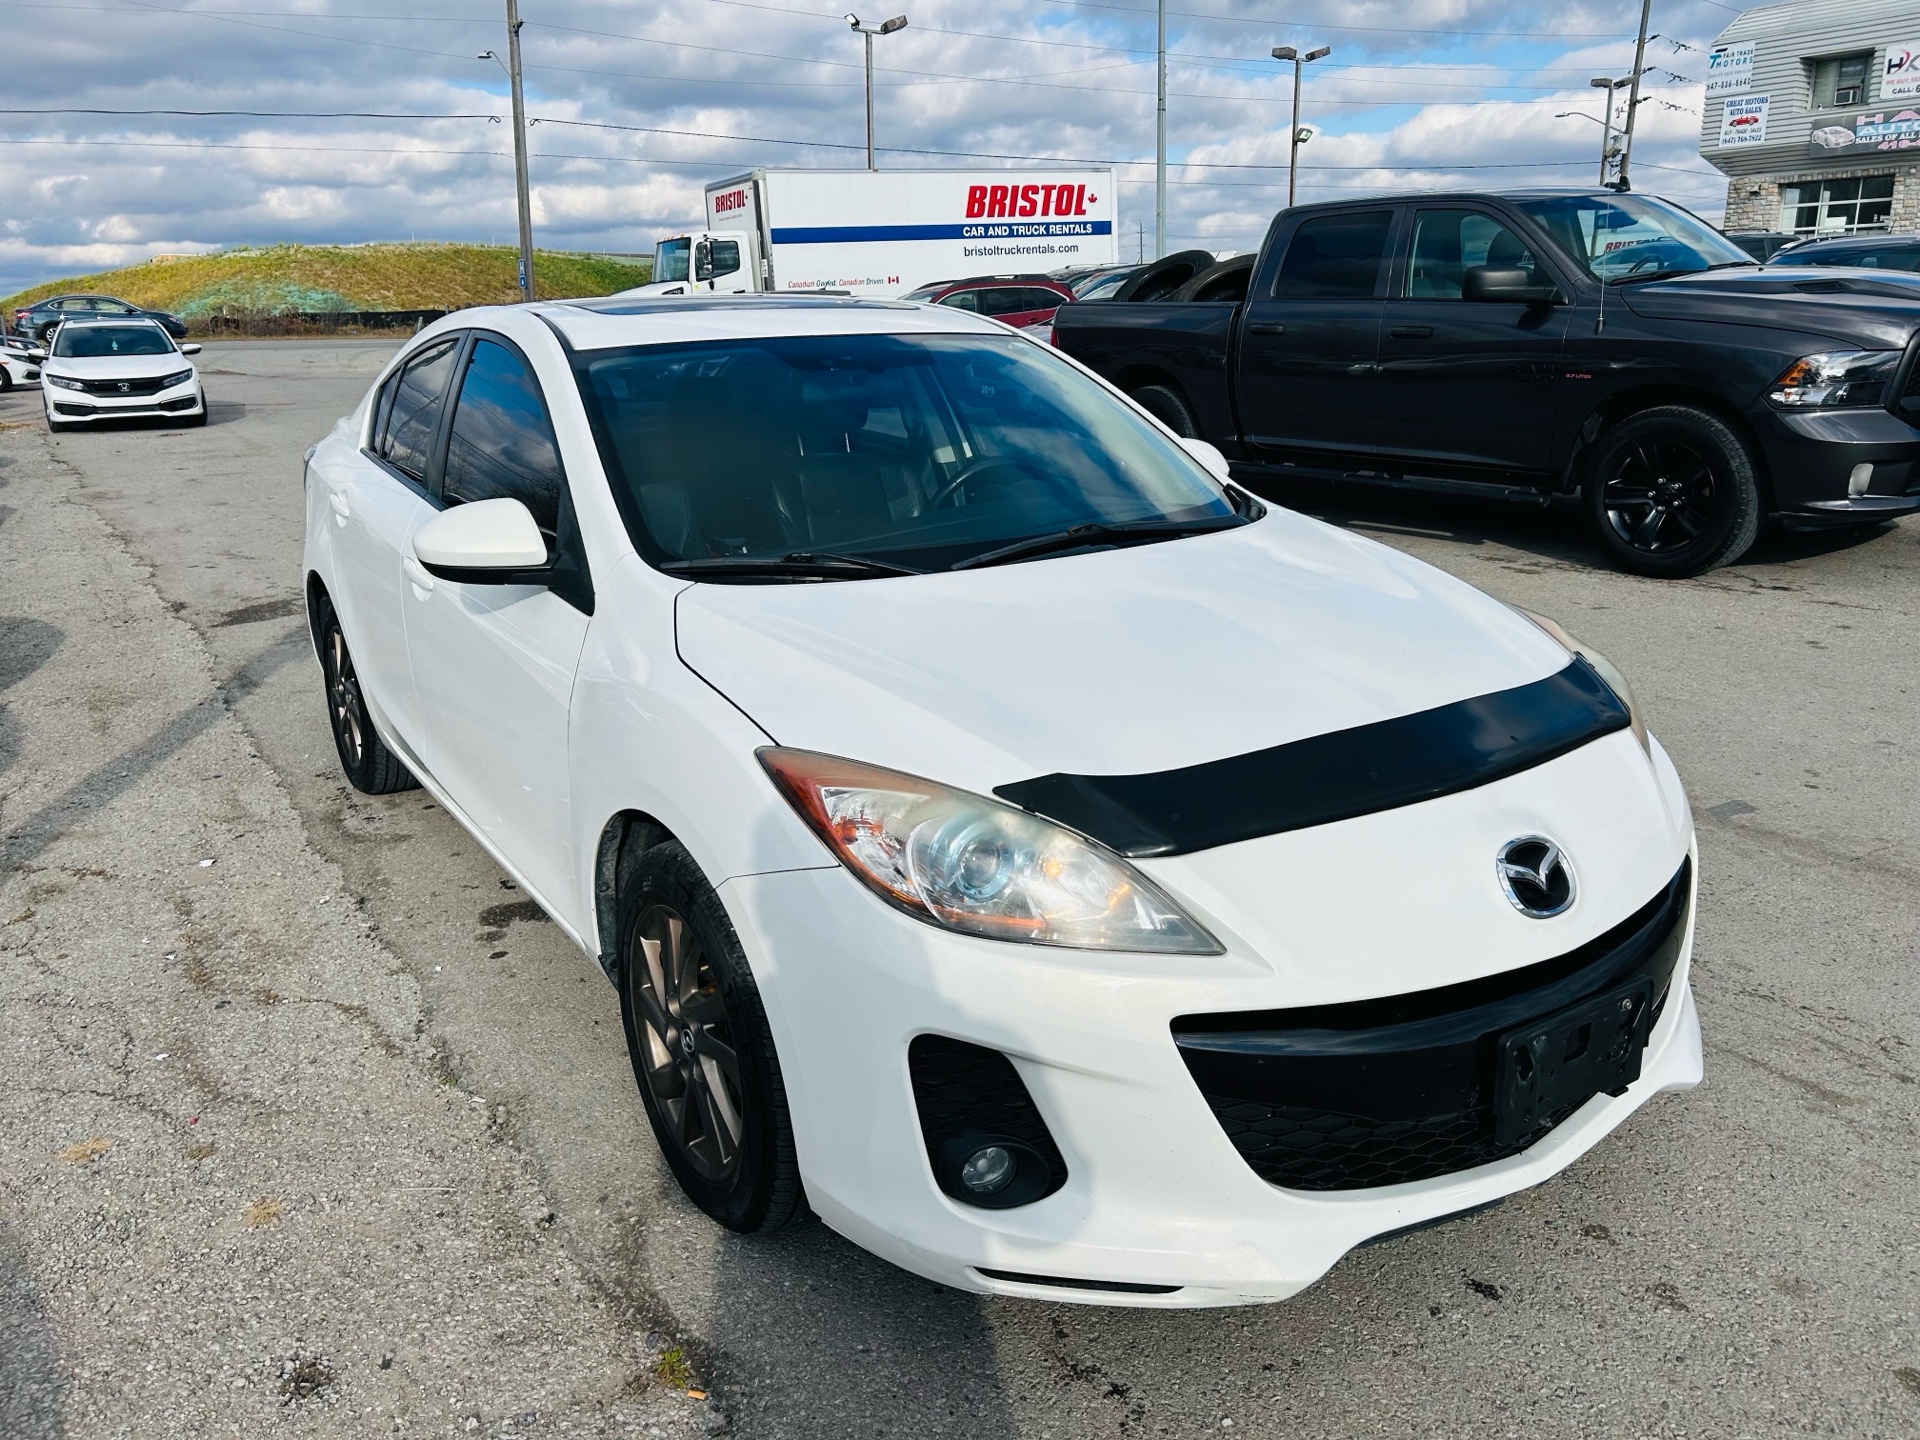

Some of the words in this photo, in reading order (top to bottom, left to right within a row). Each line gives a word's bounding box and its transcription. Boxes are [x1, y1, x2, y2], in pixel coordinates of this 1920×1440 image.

[1716, 56, 1753, 69] MOTORS
[1726, 99, 1744, 107] GREAT
[1745, 96, 1768, 105] MOTORS
[1730, 107, 1743, 115] AUTO
[1745, 106, 1762, 114] SALES
[1855, 135, 1883, 144] SALES
[1885, 133, 1898, 141] OF
[715, 189, 745, 213] BRISTOL
[965, 184, 1087, 218] BRISTOL
[963, 226, 985, 237] CAR
[988, 226, 1009, 236] AND
[1012, 225, 1047, 236] TRUCK
[1049, 224, 1092, 235] RENTALS
[964, 244, 1079, 257] bristoltruckrentals.com
[788, 280, 814, 289] Canadian
[839, 278, 865, 287] Canadian
[981, 385, 995, 395] 2019
